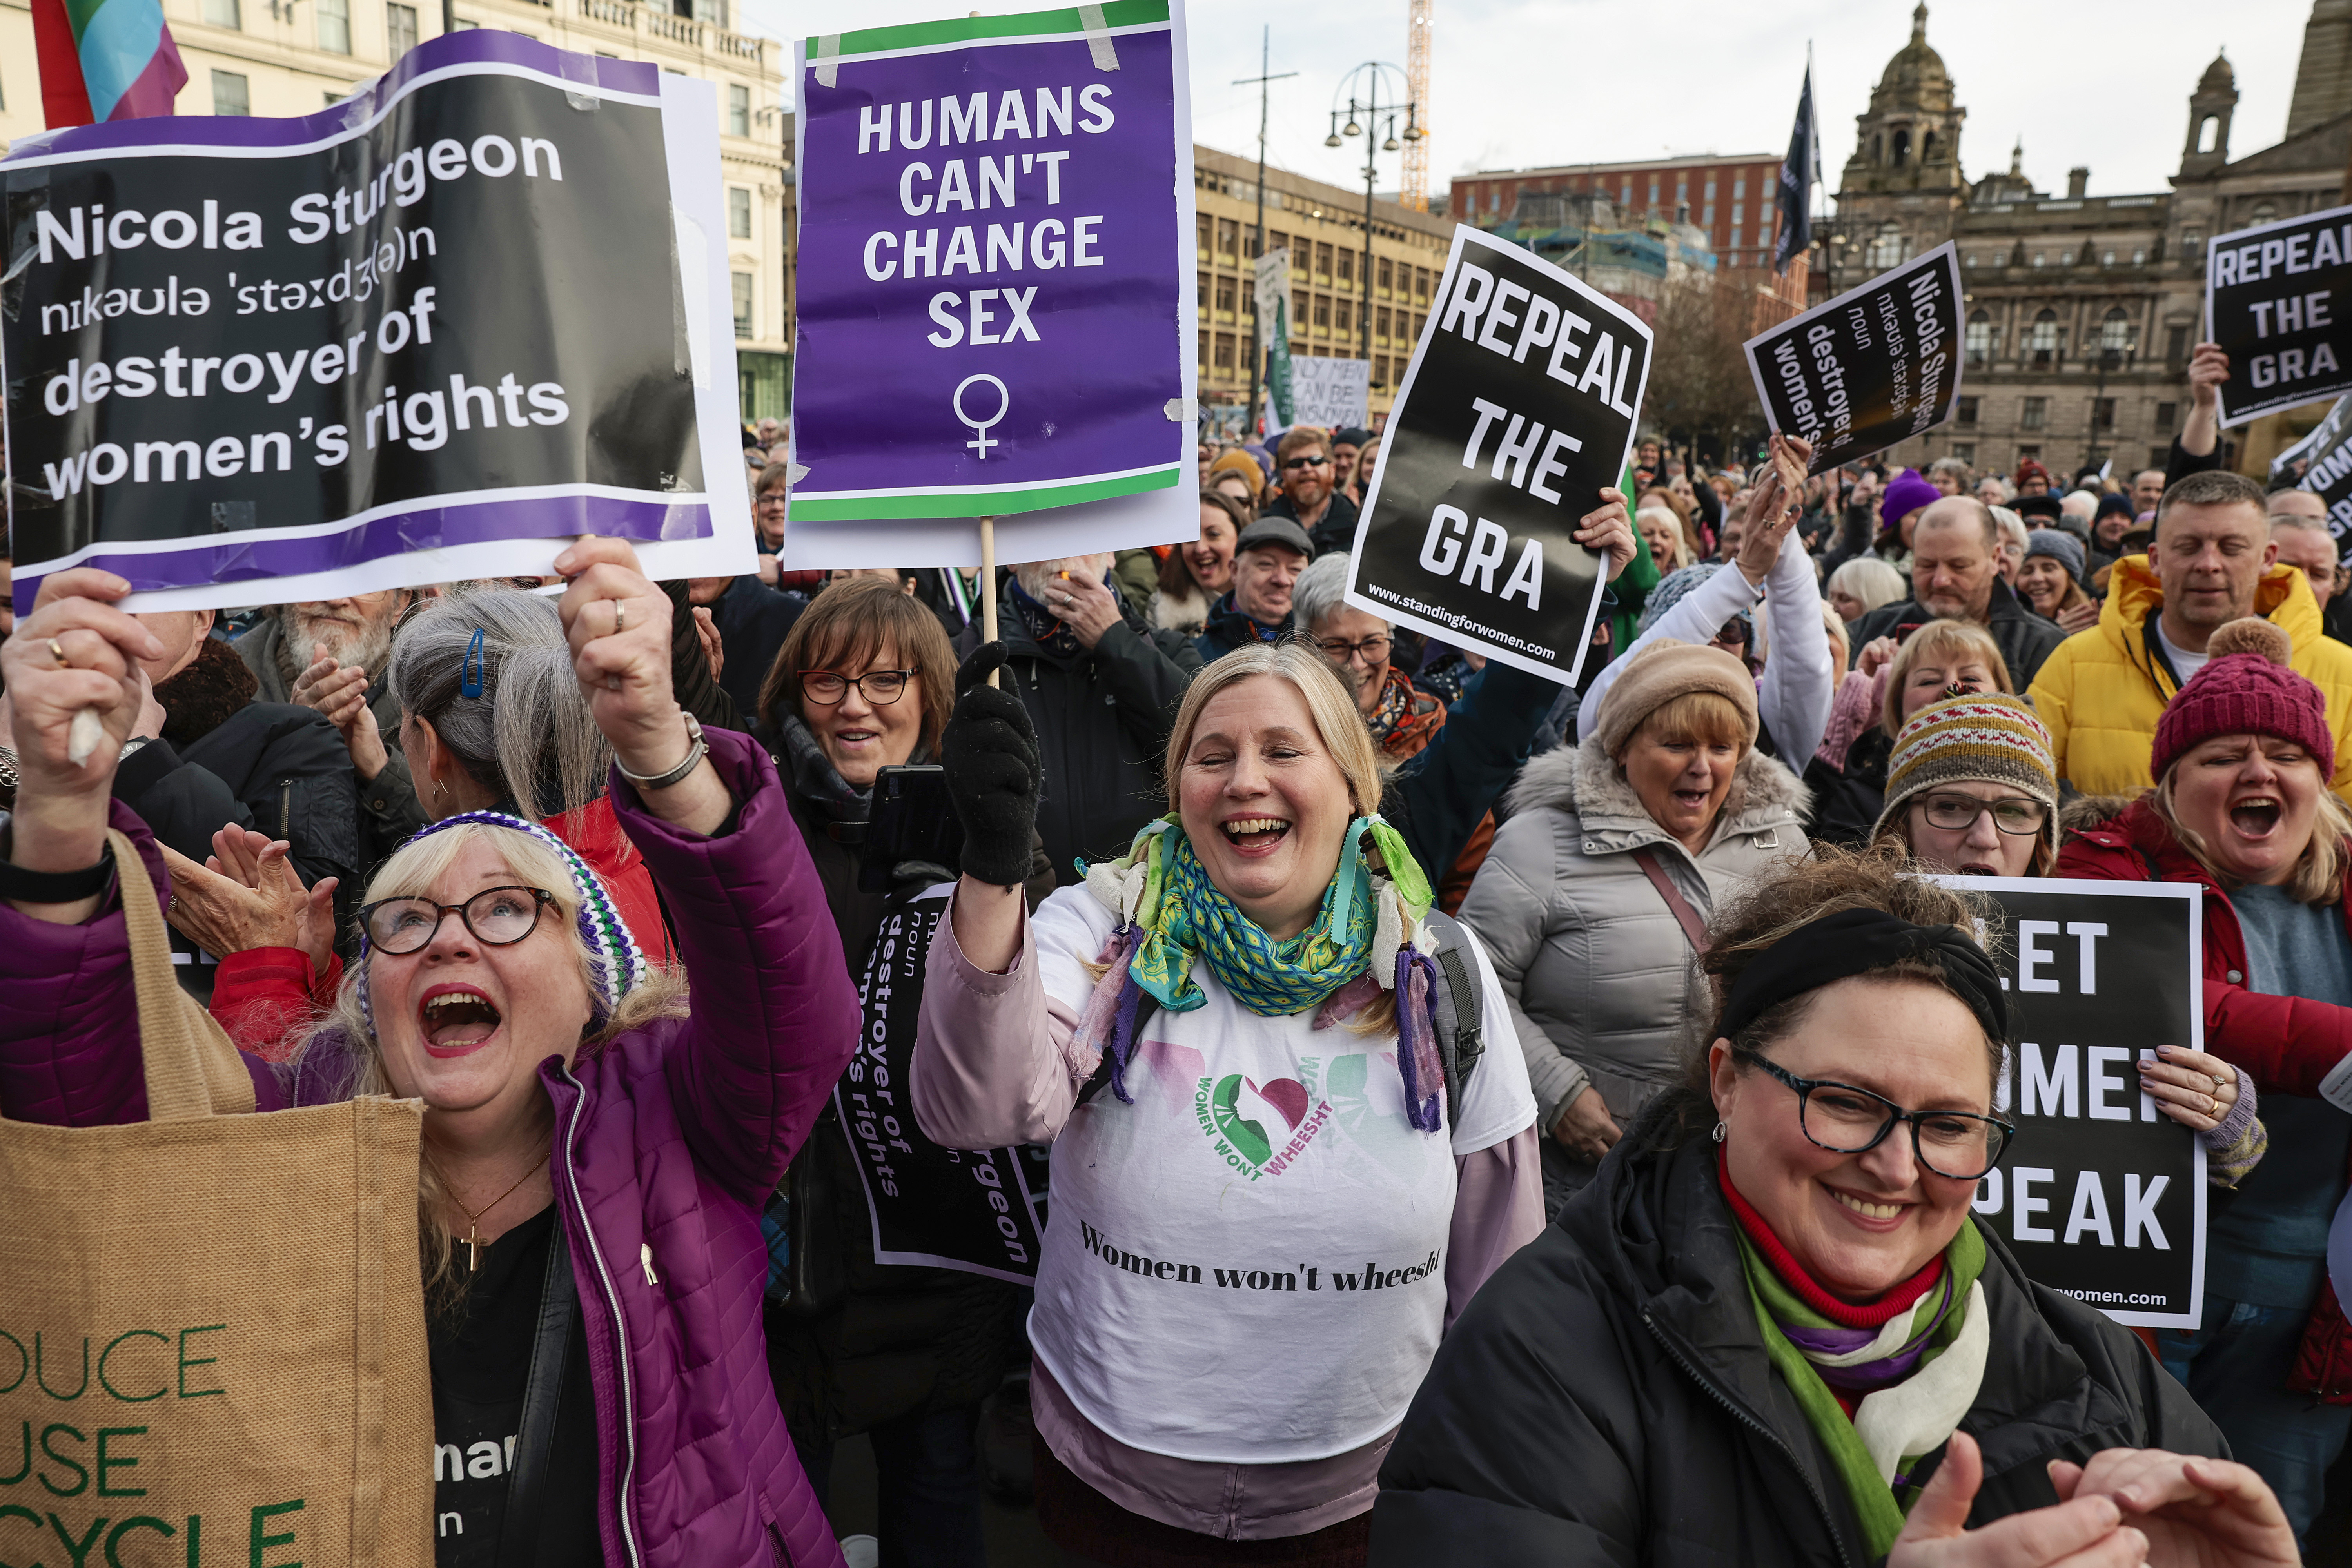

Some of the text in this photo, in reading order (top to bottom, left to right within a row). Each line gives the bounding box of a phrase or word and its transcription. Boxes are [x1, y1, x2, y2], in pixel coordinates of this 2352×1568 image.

[858, 83, 1115, 154] HUMANS
[37, 134, 563, 264] Nicola Sturgeon
[899, 150, 1070, 216] CAN'T
[864, 215, 1103, 281] CHANGE
[44, 287, 436, 416] destroyer of
[927, 286, 1041, 348] SEX
[1441, 261, 1633, 419] REPEAL
[1847, 306, 1872, 350] noun
[1907, 269, 1947, 435] Nicola Sturgeon
[2249, 290, 2332, 339] THE
[1294, 380, 1355, 405] CAN BE
[1774, 338, 1826, 445] women's
[1807, 324, 1852, 434] destroyer
[2250, 342, 2339, 389] GRA
[44, 372, 570, 501] women’s rights
[1462, 397, 1582, 505] THE
[1419, 504, 1543, 612] GRA
[1368, 583, 1555, 661] www.standingforwomen.com
[904, 911, 922, 977] noun
[867, 914, 912, 1154] destroyer of
[852, 1093, 898, 1198] rights
[1195, 1077, 1217, 1137] WOMEN
[1263, 1100, 1333, 1176] WHEESHT
[972, 1149, 1028, 1264] rgeon
[1079, 1218, 1441, 1292] Women won't wheesht
[2054, 1287, 2167, 1306] women.com
